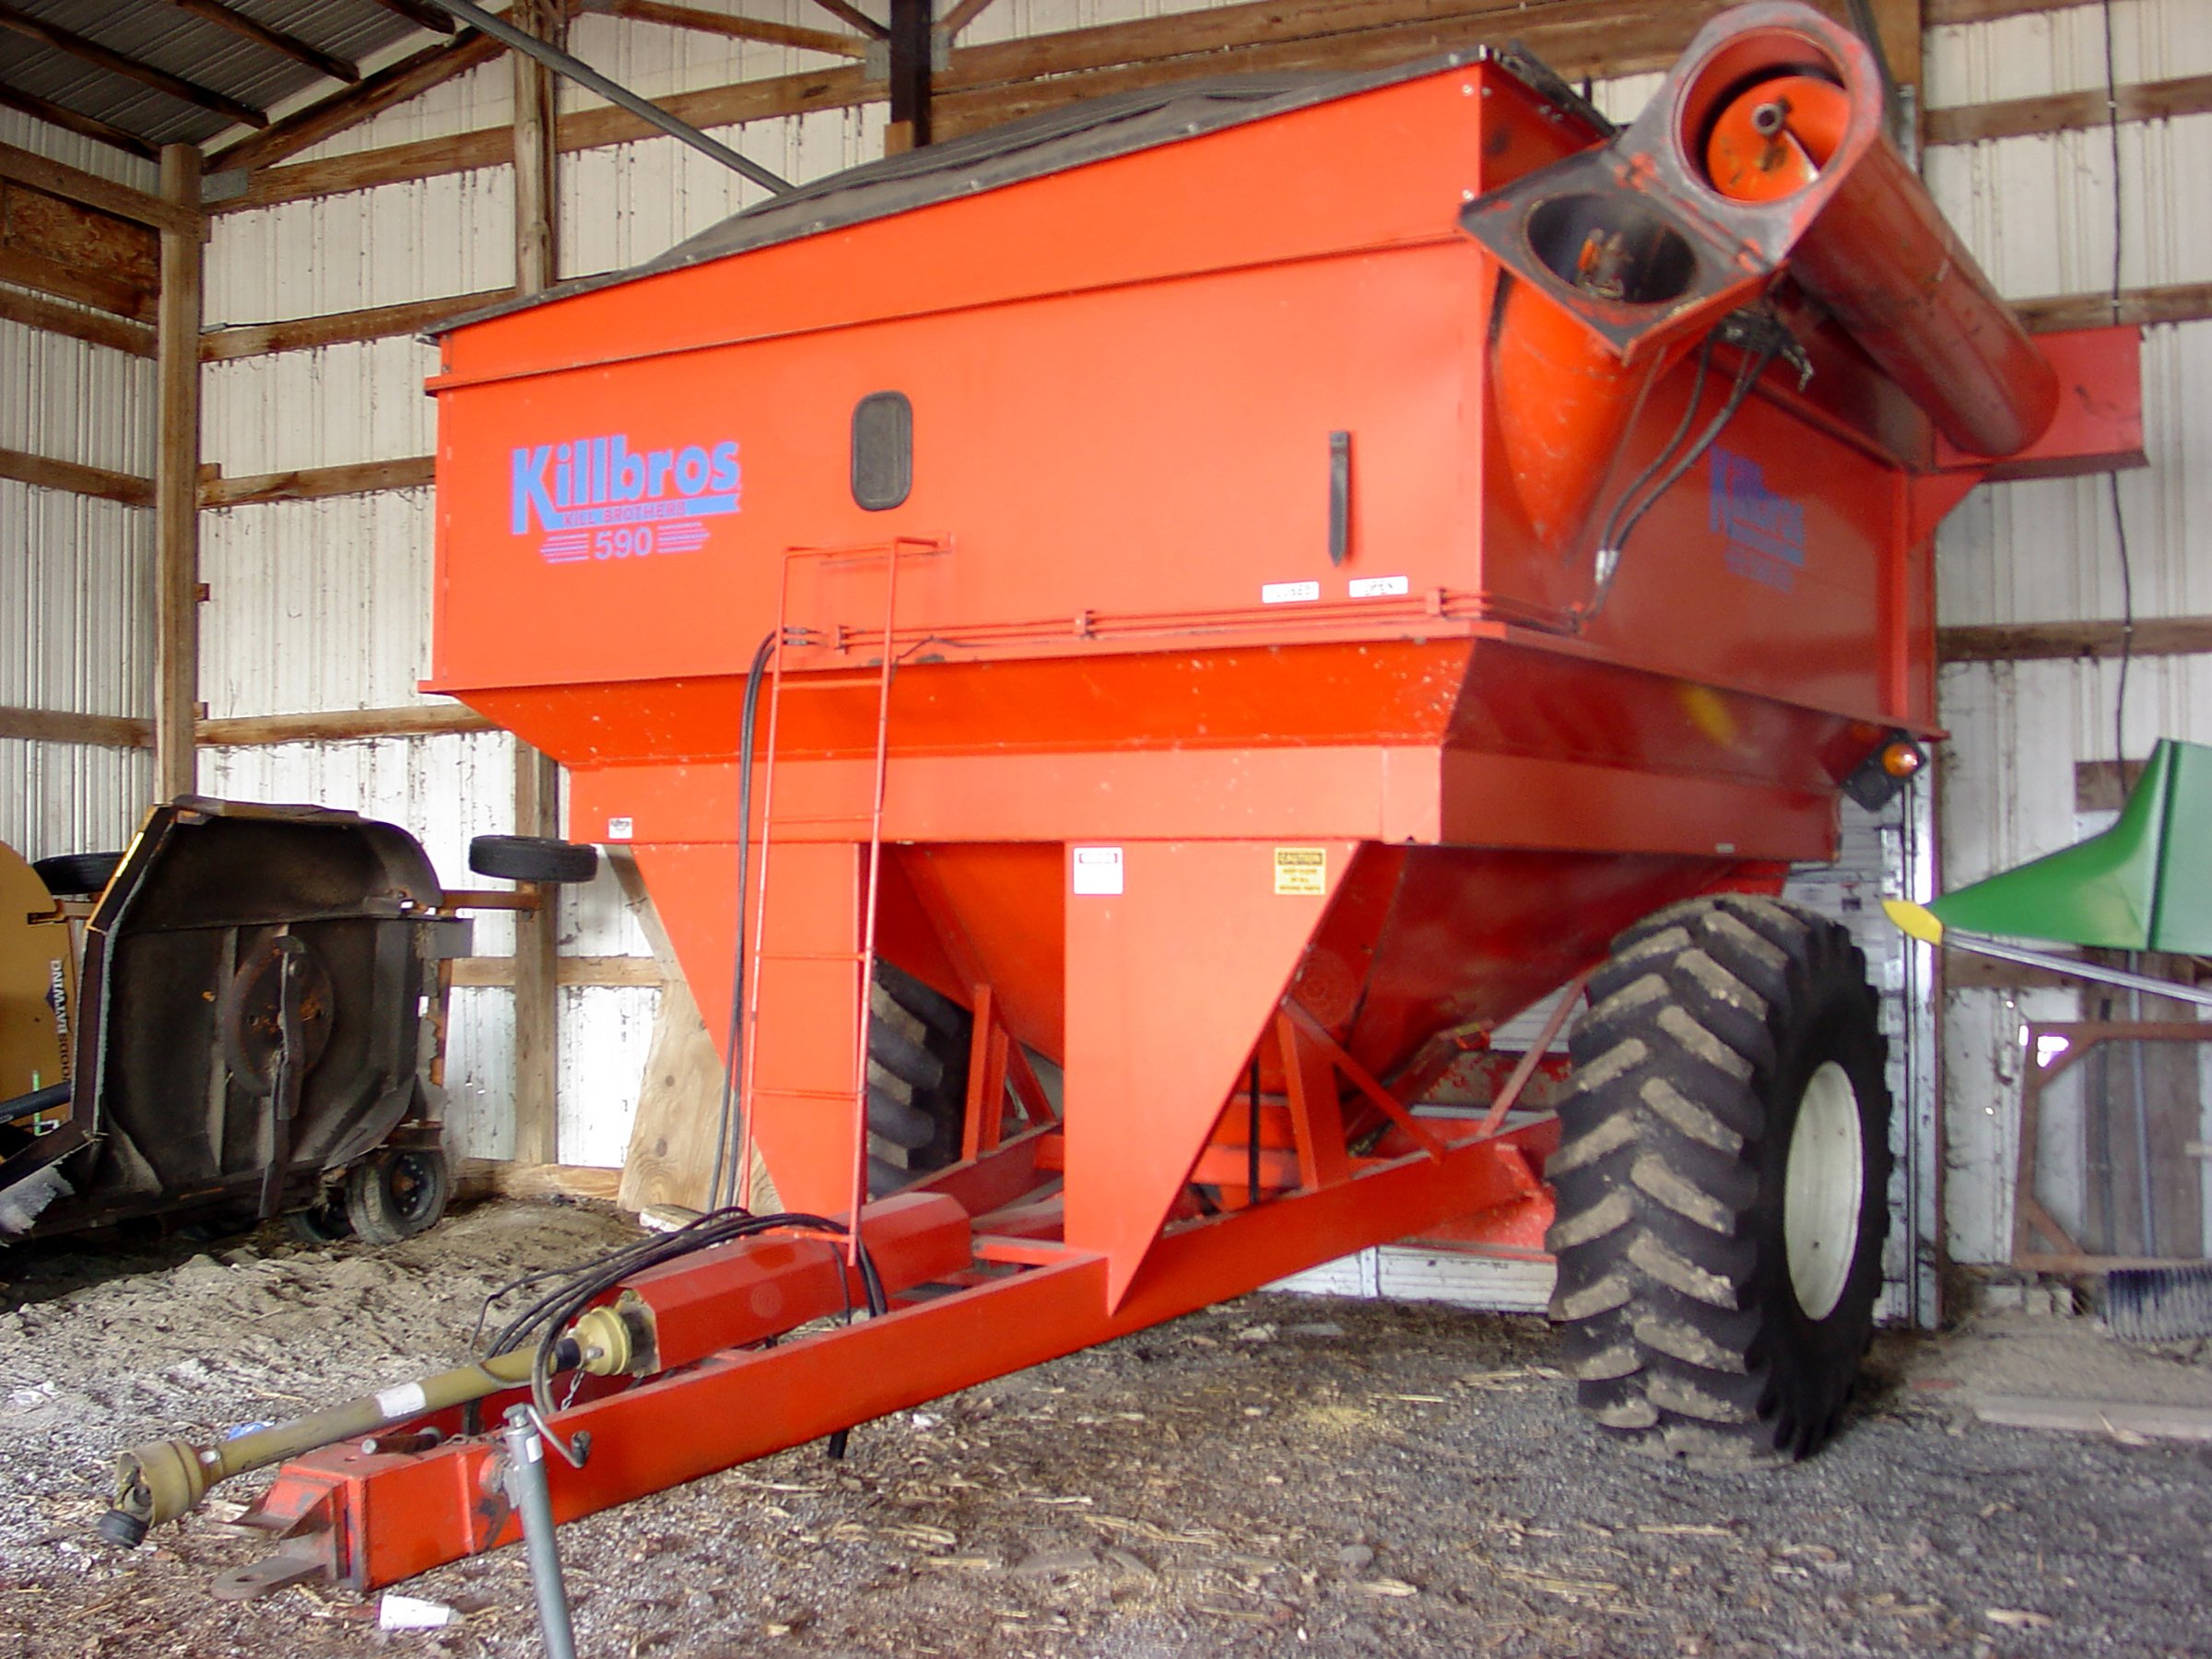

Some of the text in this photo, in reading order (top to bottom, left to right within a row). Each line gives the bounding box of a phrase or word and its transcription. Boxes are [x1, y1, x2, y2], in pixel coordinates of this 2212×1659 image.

[512, 434, 741, 535] Killbros
[563, 500, 687, 526] KILL BROTHERS
[594, 526, 653, 559] 590
[50, 959, 68, 1033] BATWING
